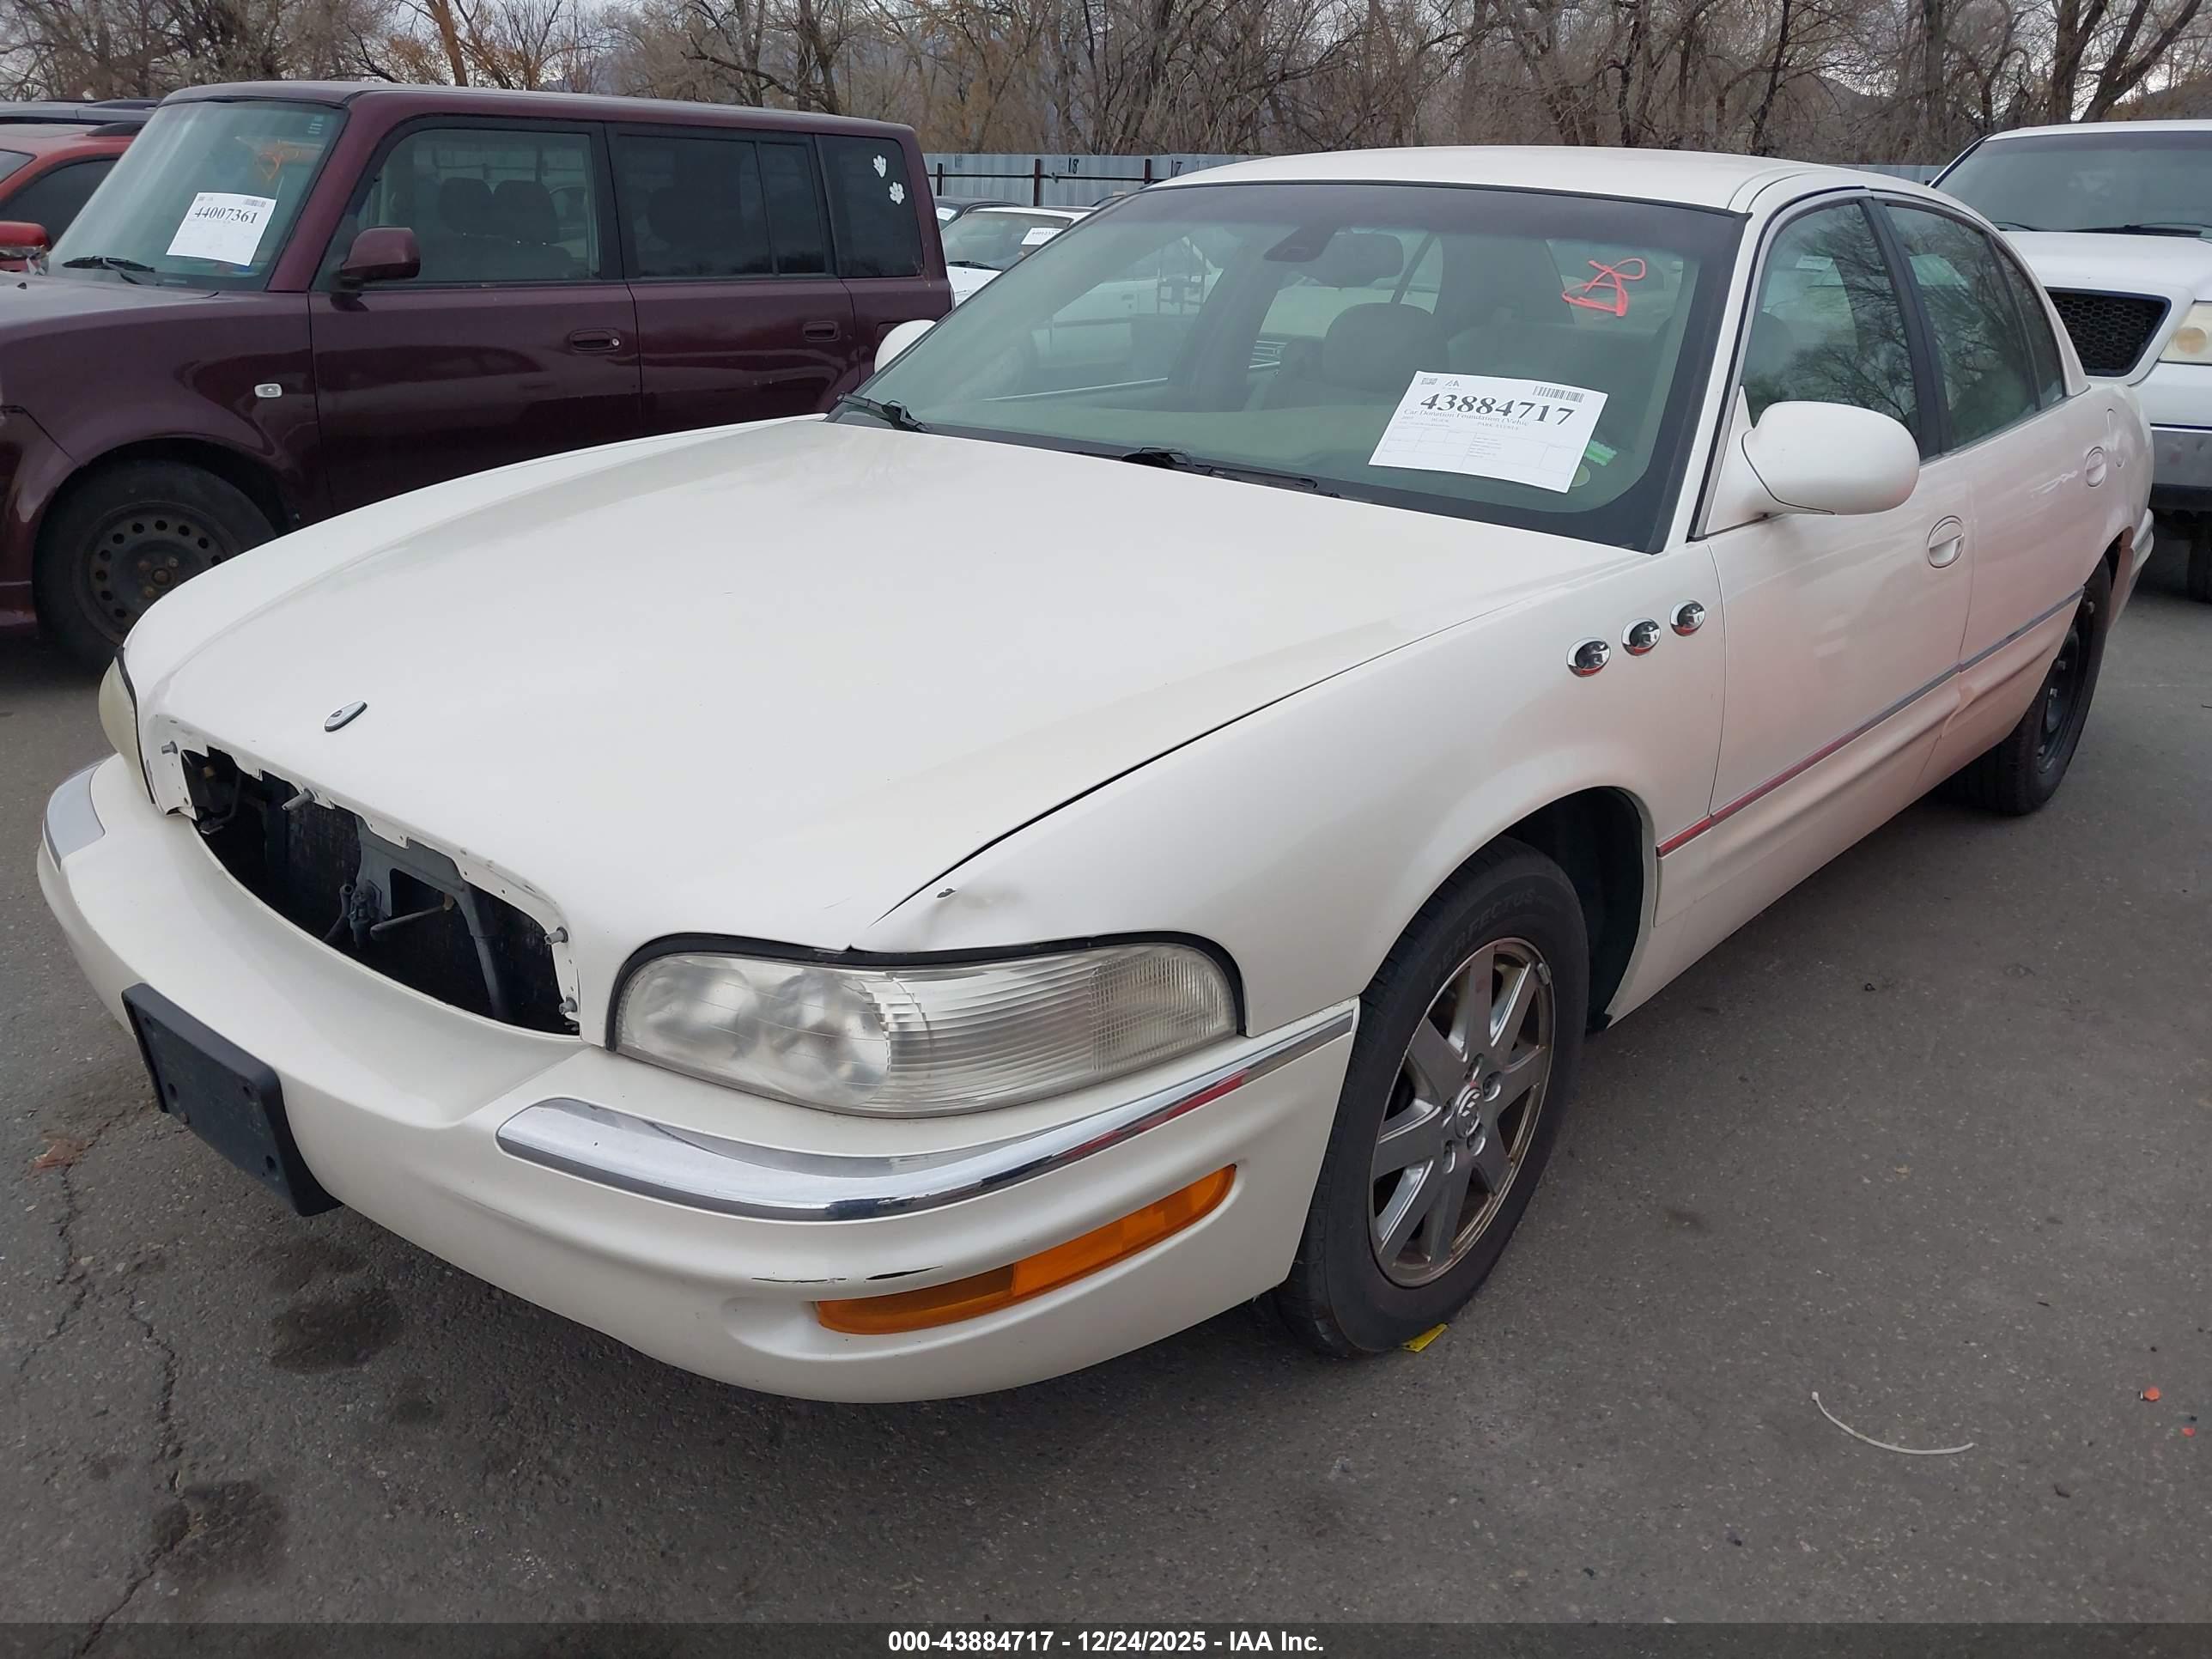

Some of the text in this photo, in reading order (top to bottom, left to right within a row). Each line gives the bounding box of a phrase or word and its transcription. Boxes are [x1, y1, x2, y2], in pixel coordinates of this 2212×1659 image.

[1068, 157, 1079, 174] 18
[1170, 159, 1184, 178] 17
[195, 206, 259, 224] 44007361
[1420, 393, 1576, 426] 43884717
